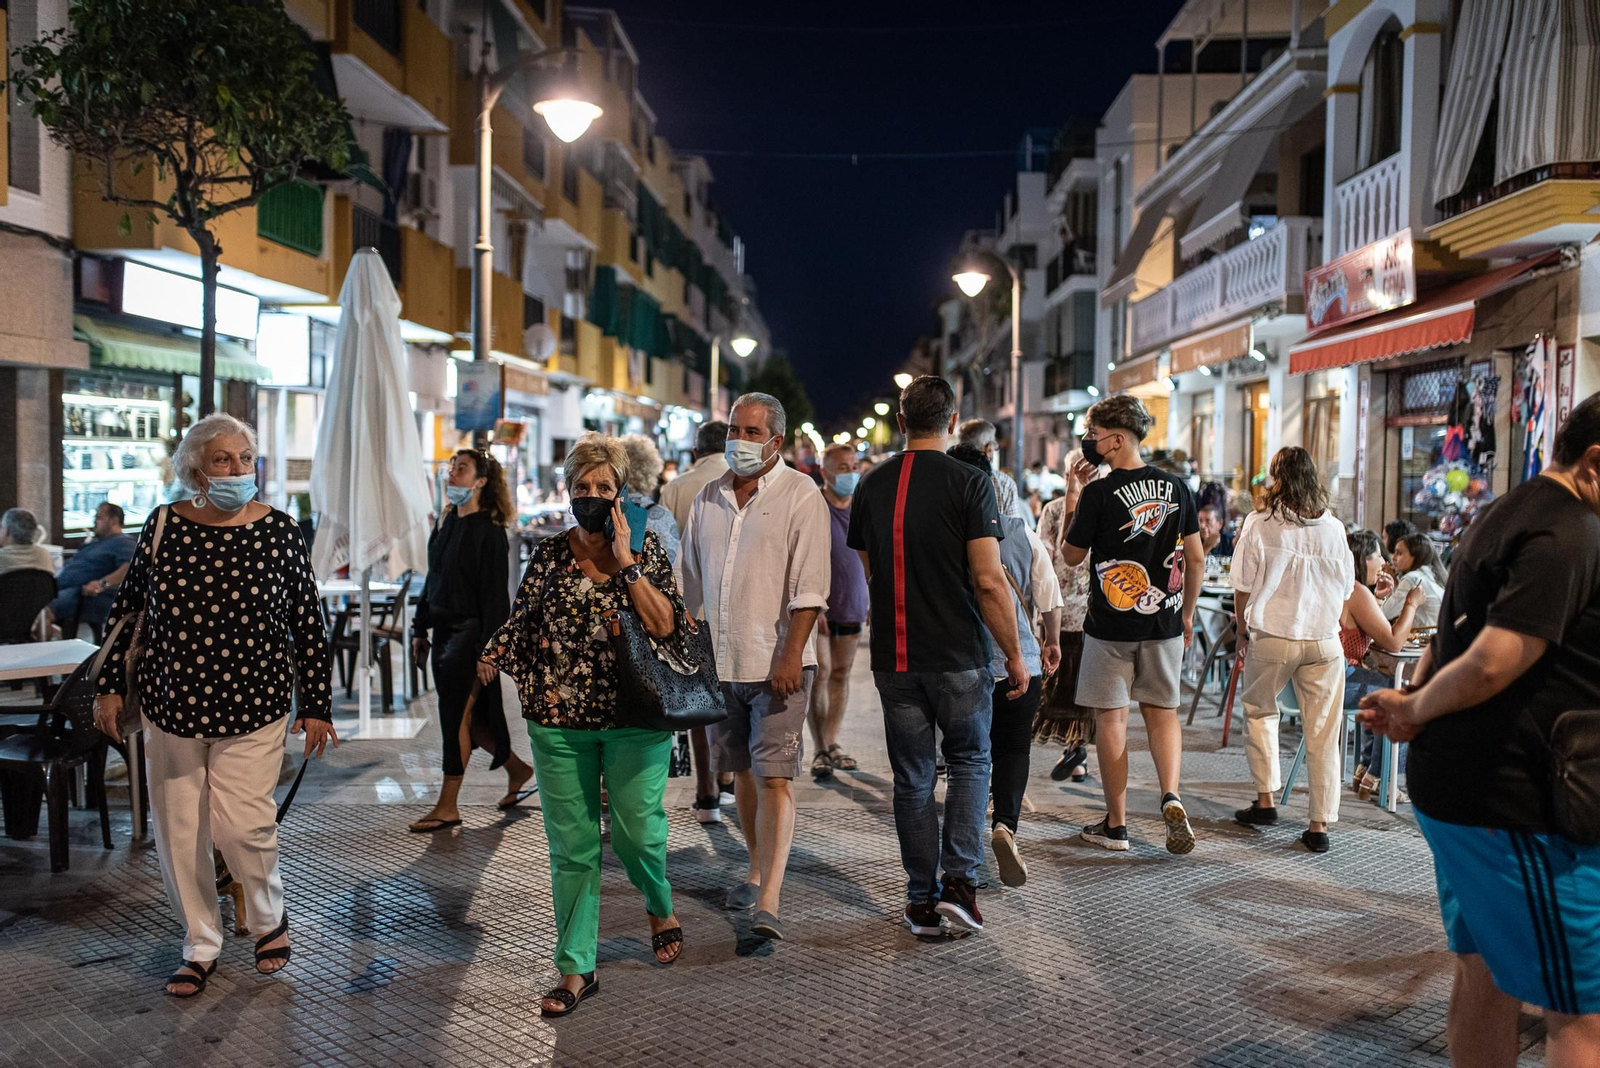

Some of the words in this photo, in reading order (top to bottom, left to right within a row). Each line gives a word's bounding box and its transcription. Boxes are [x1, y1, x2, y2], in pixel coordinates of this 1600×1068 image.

[1113, 479, 1173, 508] THUNDER
[1133, 505, 1160, 532] OKC
[1097, 563, 1158, 608] LAKERS
